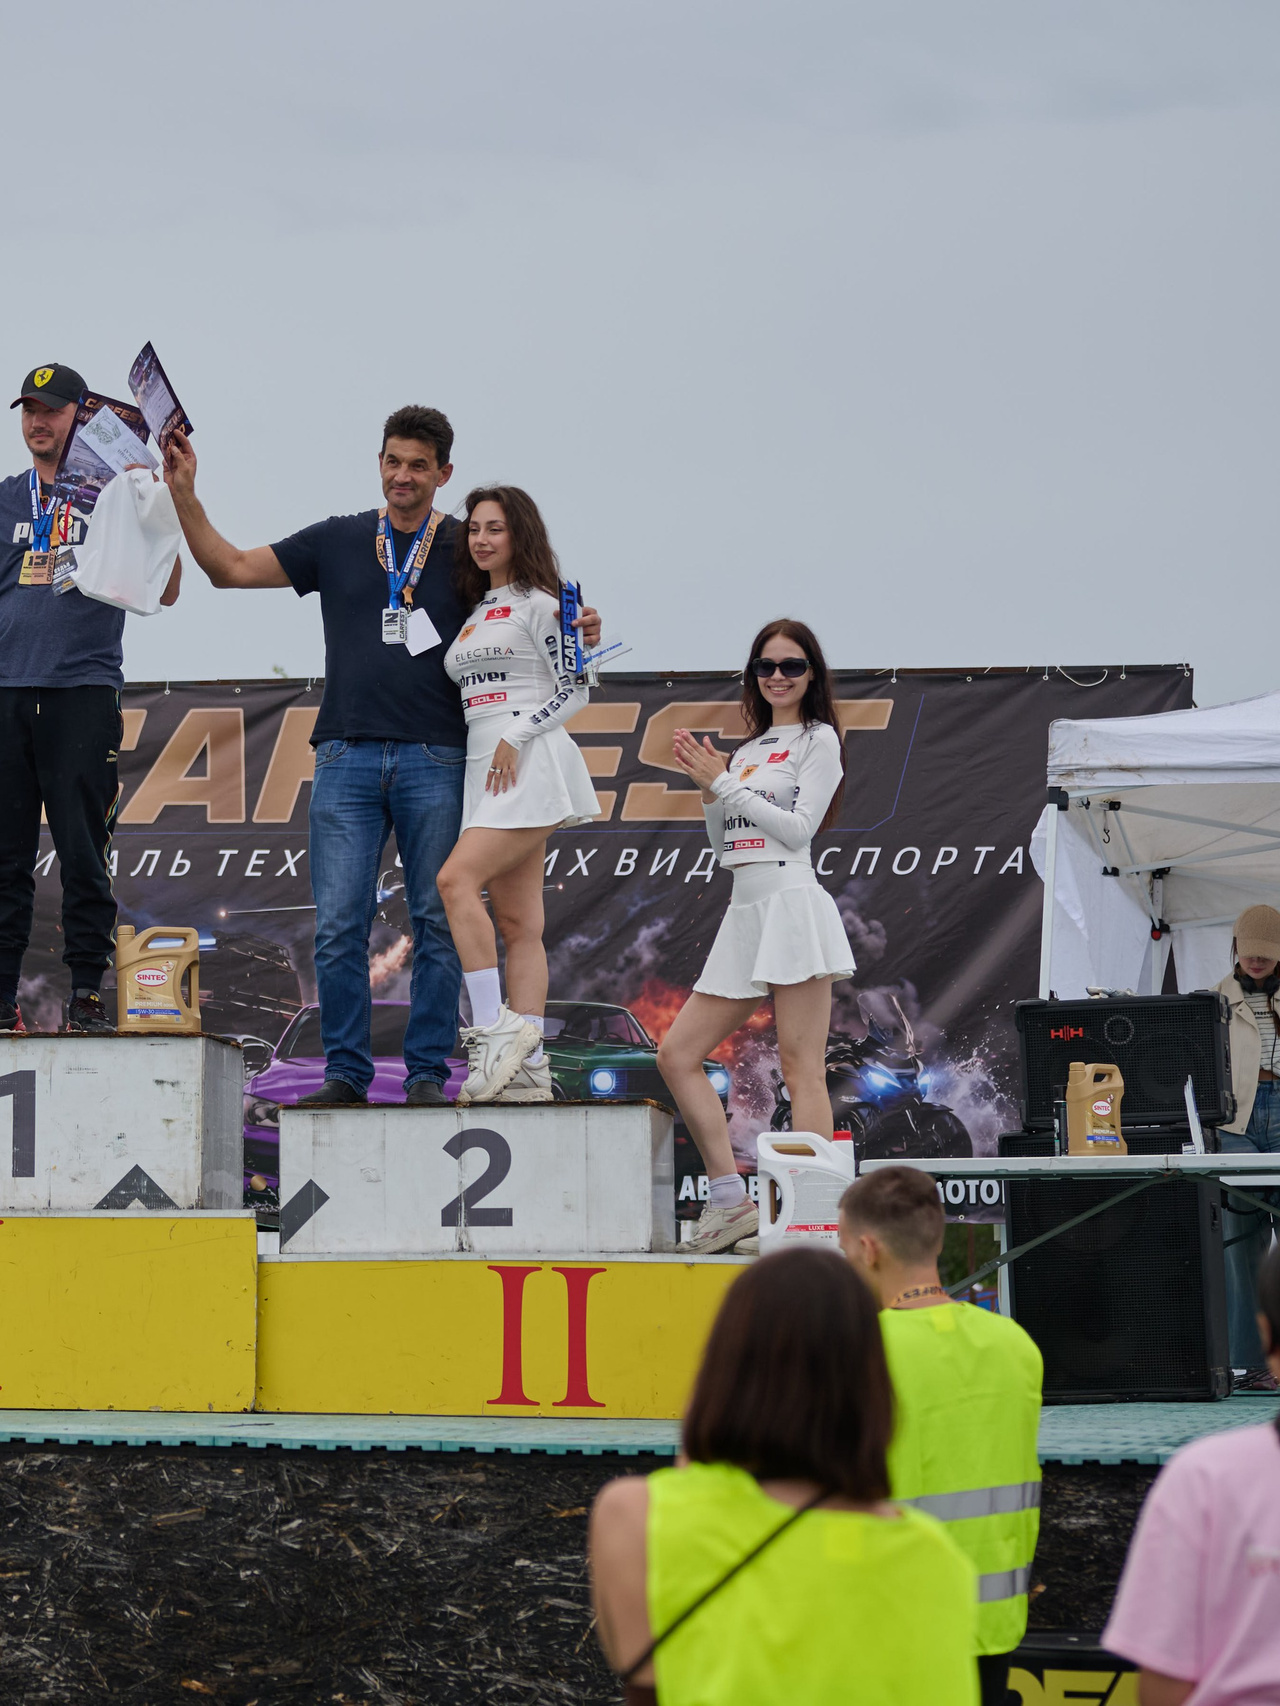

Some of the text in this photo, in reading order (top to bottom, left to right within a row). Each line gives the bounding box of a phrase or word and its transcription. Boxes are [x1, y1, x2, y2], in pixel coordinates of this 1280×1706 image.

[417, 525, 435, 566] CARFEST
[455, 646, 515, 663] ELECTRA
[613, 847, 720, 883] ВИД
[818, 846, 1024, 876] СПОРТА
[441, 1128, 514, 1227] 2
[486, 1265, 608, 1408] II
